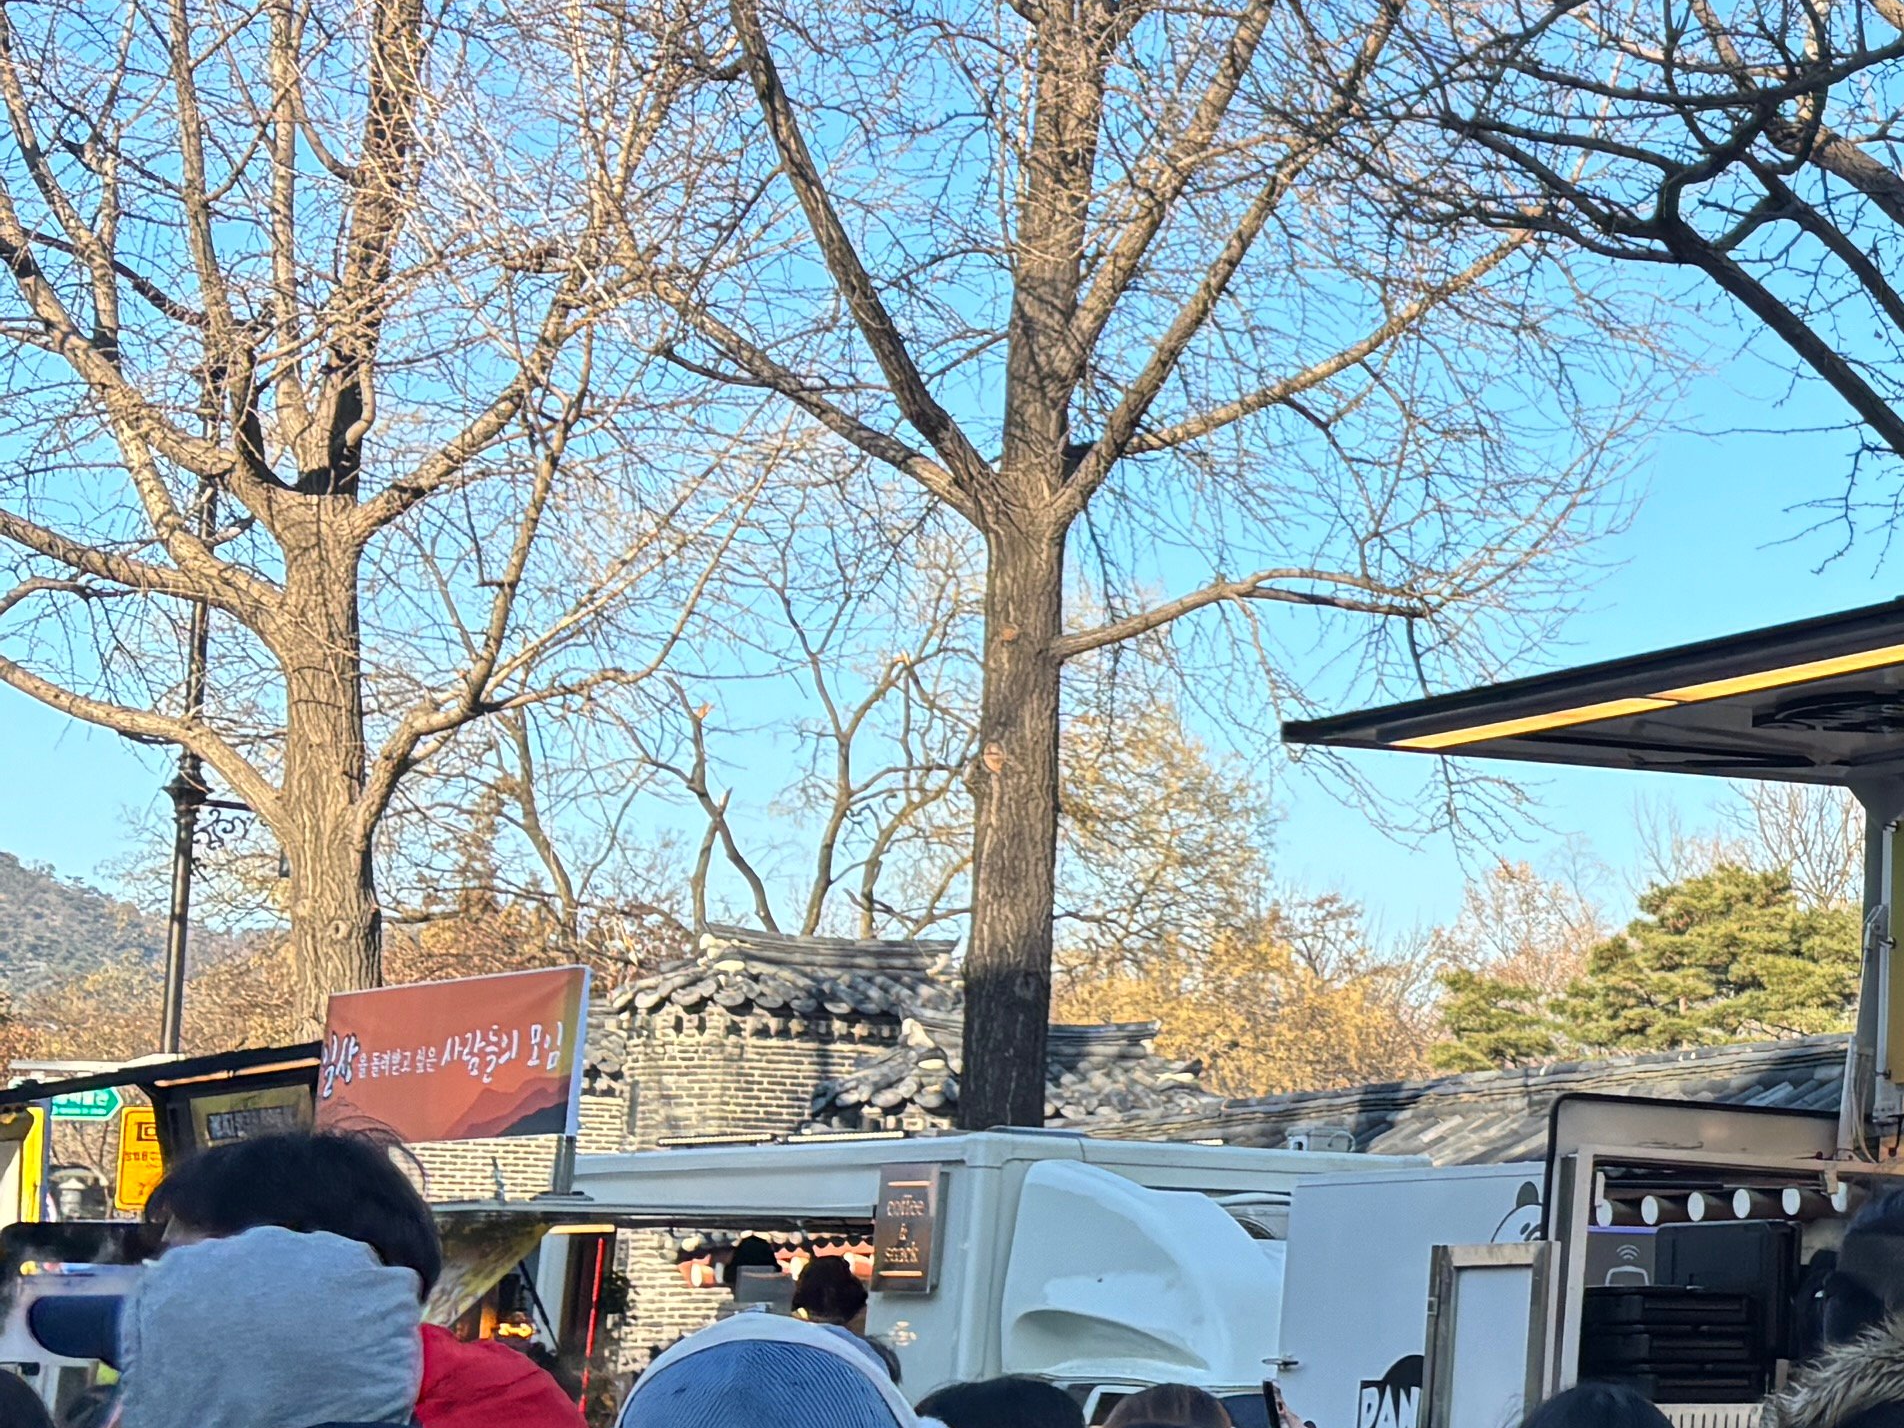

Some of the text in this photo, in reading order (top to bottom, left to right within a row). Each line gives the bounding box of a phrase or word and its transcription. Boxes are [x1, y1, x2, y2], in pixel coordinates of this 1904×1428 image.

[440, 1024, 520, 1084] 사람들의
[526, 1021, 564, 1071] 모임
[886, 1194, 926, 1217] coffee
